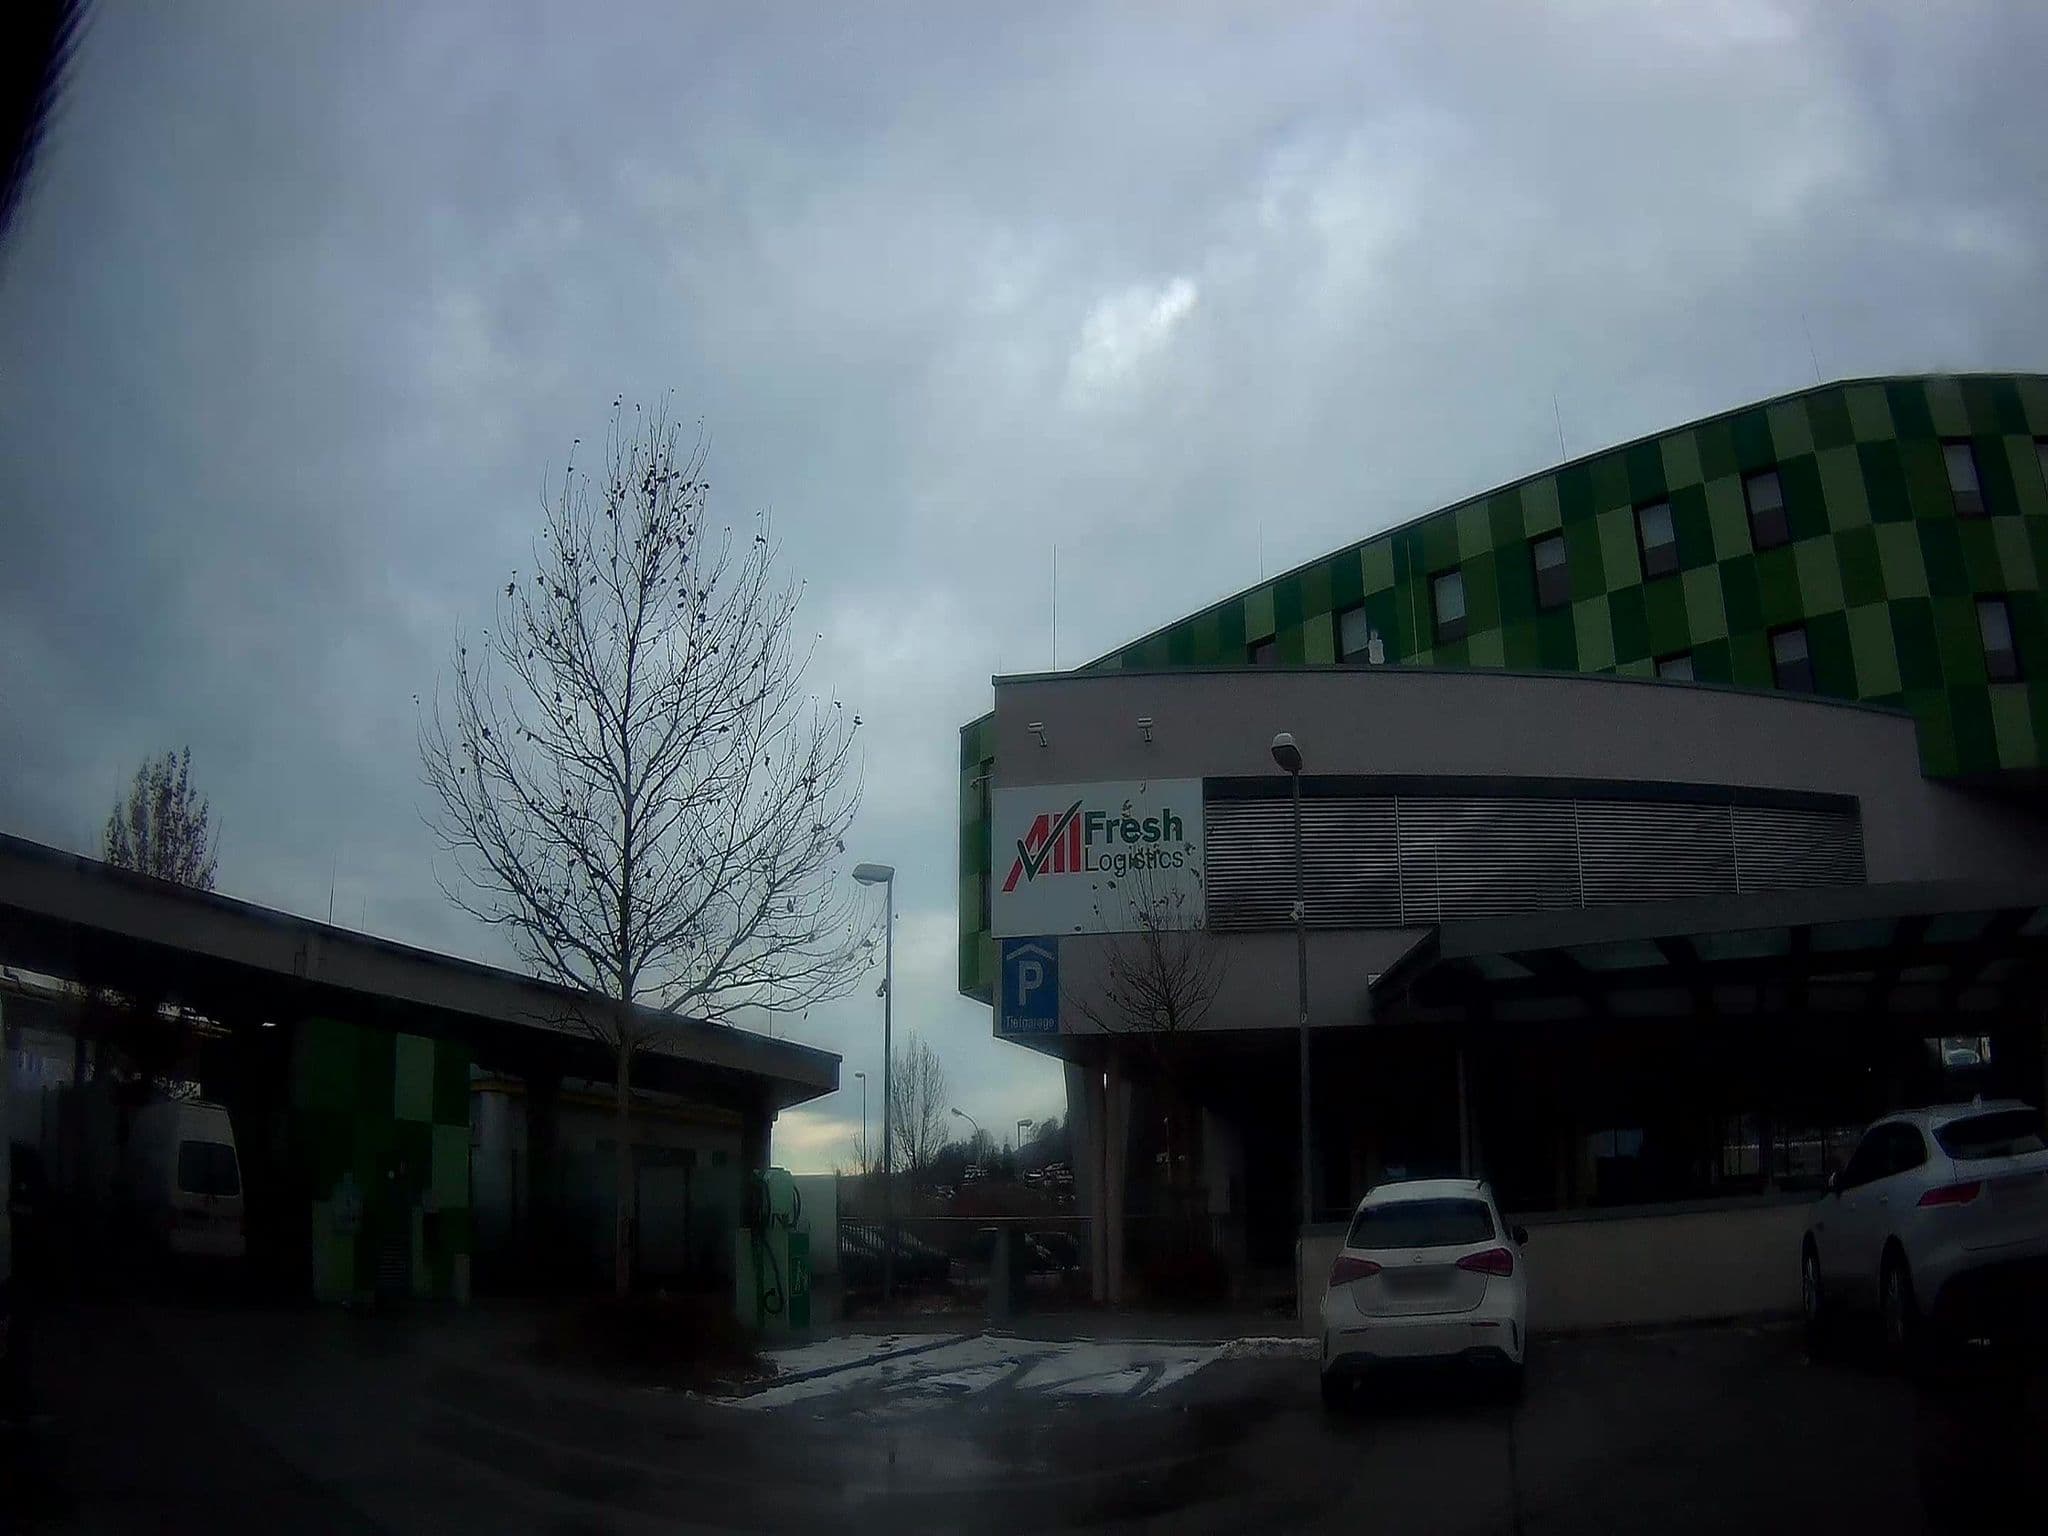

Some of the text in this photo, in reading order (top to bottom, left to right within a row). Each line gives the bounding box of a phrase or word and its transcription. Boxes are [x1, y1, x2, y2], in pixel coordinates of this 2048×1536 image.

[1085, 808, 1183, 845] Fresh
[1085, 847, 1184, 877] Logistics
[1019, 960, 1044, 1006] P
